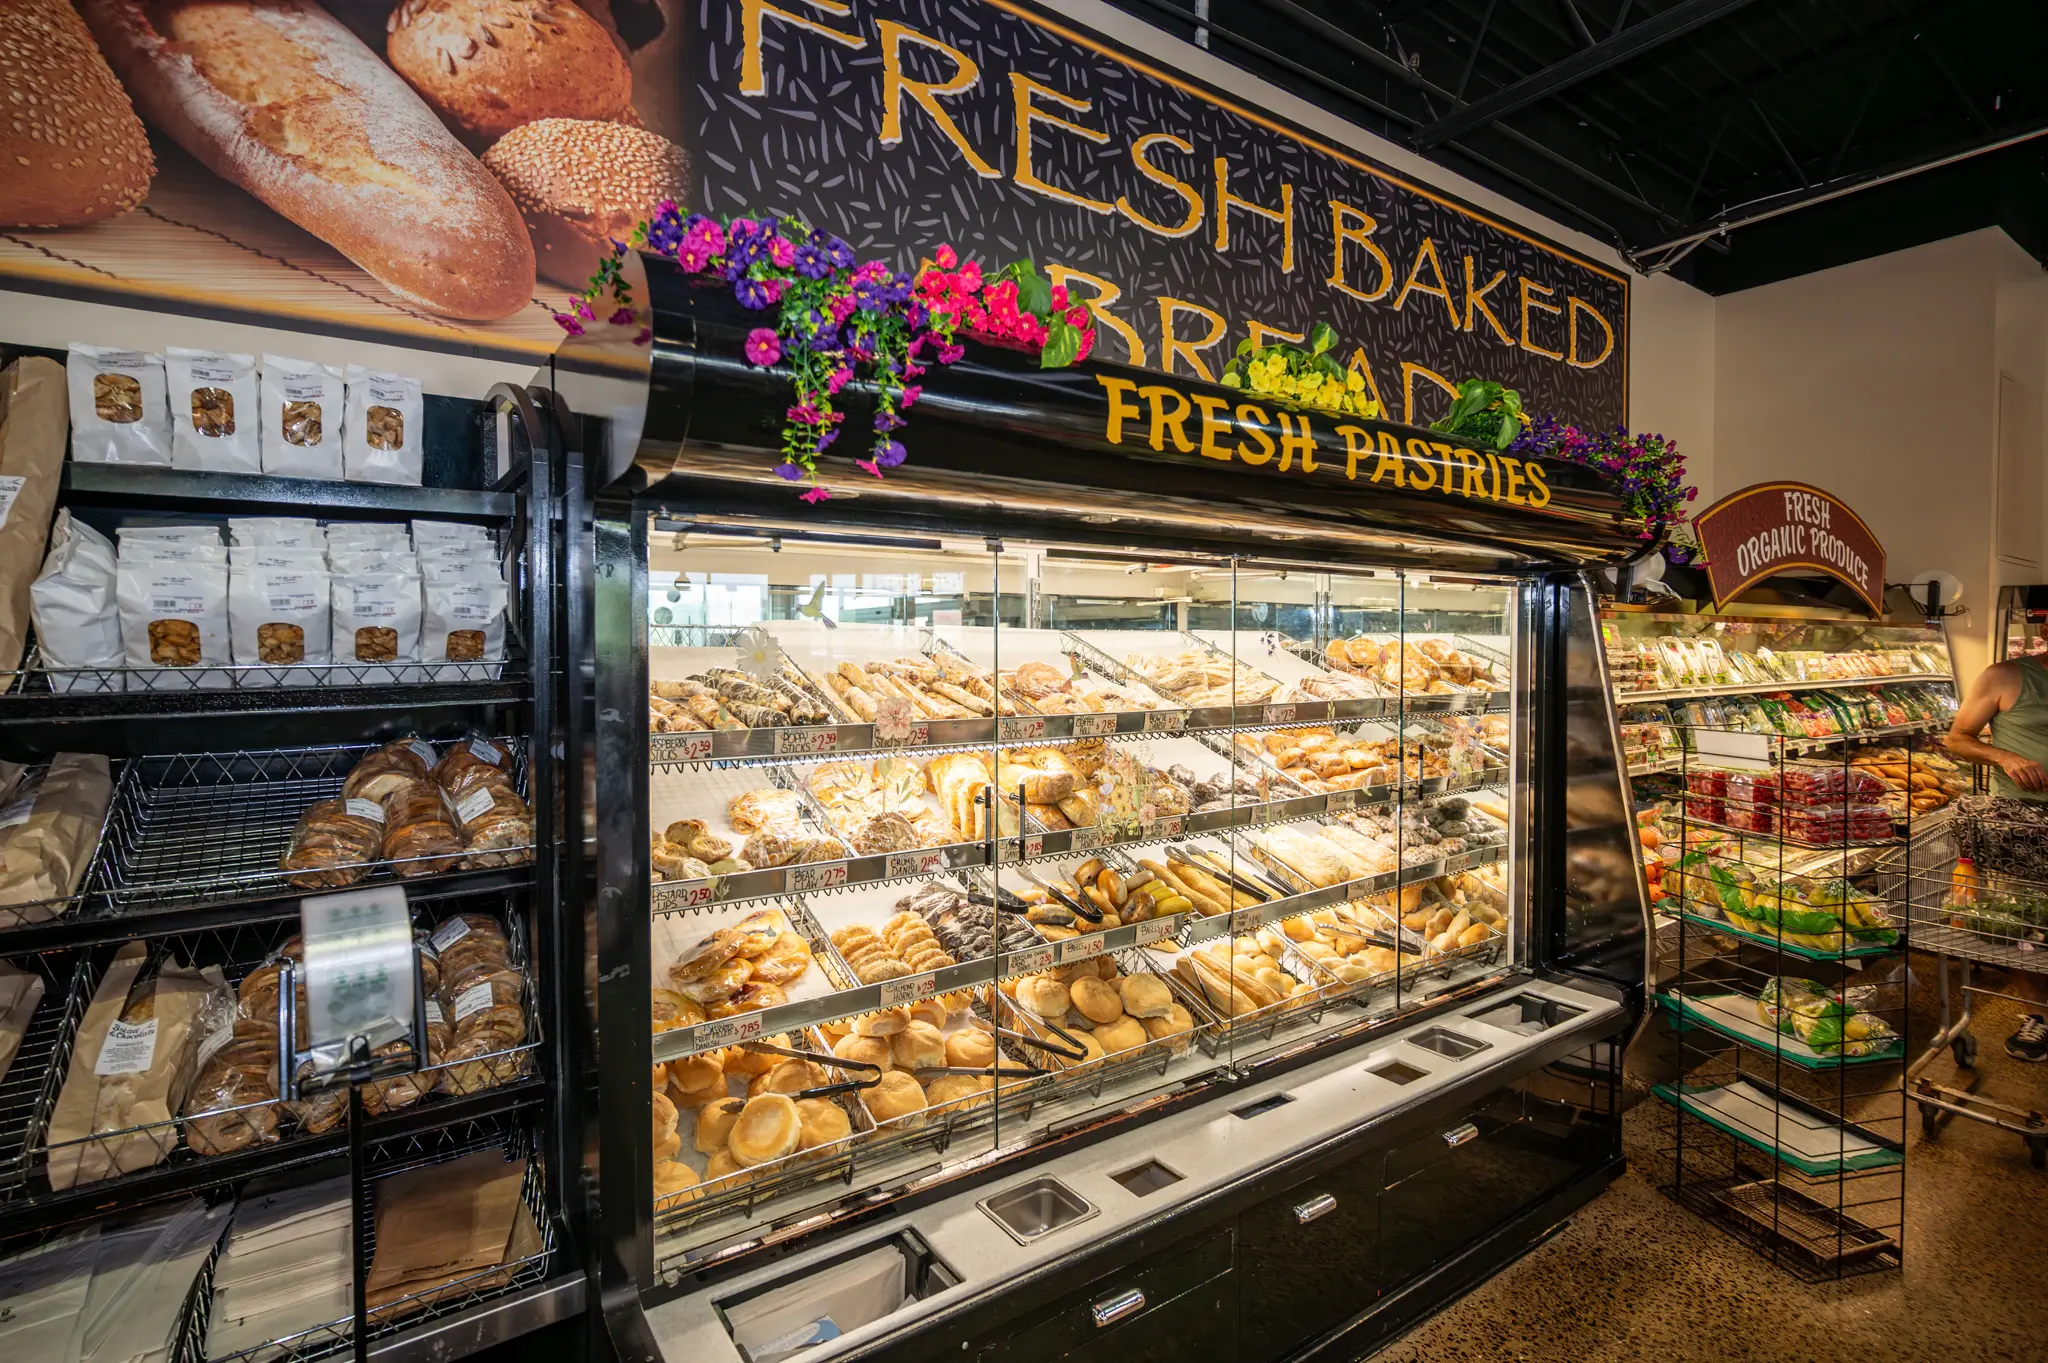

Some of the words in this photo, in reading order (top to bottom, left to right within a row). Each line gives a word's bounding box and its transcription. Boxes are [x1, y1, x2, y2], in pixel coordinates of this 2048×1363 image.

[738, 0, 1293, 274] FRESH
[1326, 200, 1614, 369] BAKED
[1095, 373, 1319, 474] FRESH
[1334, 424, 1551, 508] PASTRIES
[1784, 491, 1831, 529] FRESH
[1737, 524, 1806, 577] ORGANIC
[1809, 527, 1869, 591] PRODUCE
[780, 742, 811, 753] STICKS
[1004, 850, 1020, 860] DANI
[795, 868, 815, 882] BEAR
[794, 877, 818, 890] CLAW
[652, 889, 687, 901] USTARD
[652, 900, 677, 911] UPS
[893, 990, 914, 1002] HORNS
[112, 1023, 140, 1034] Bread
